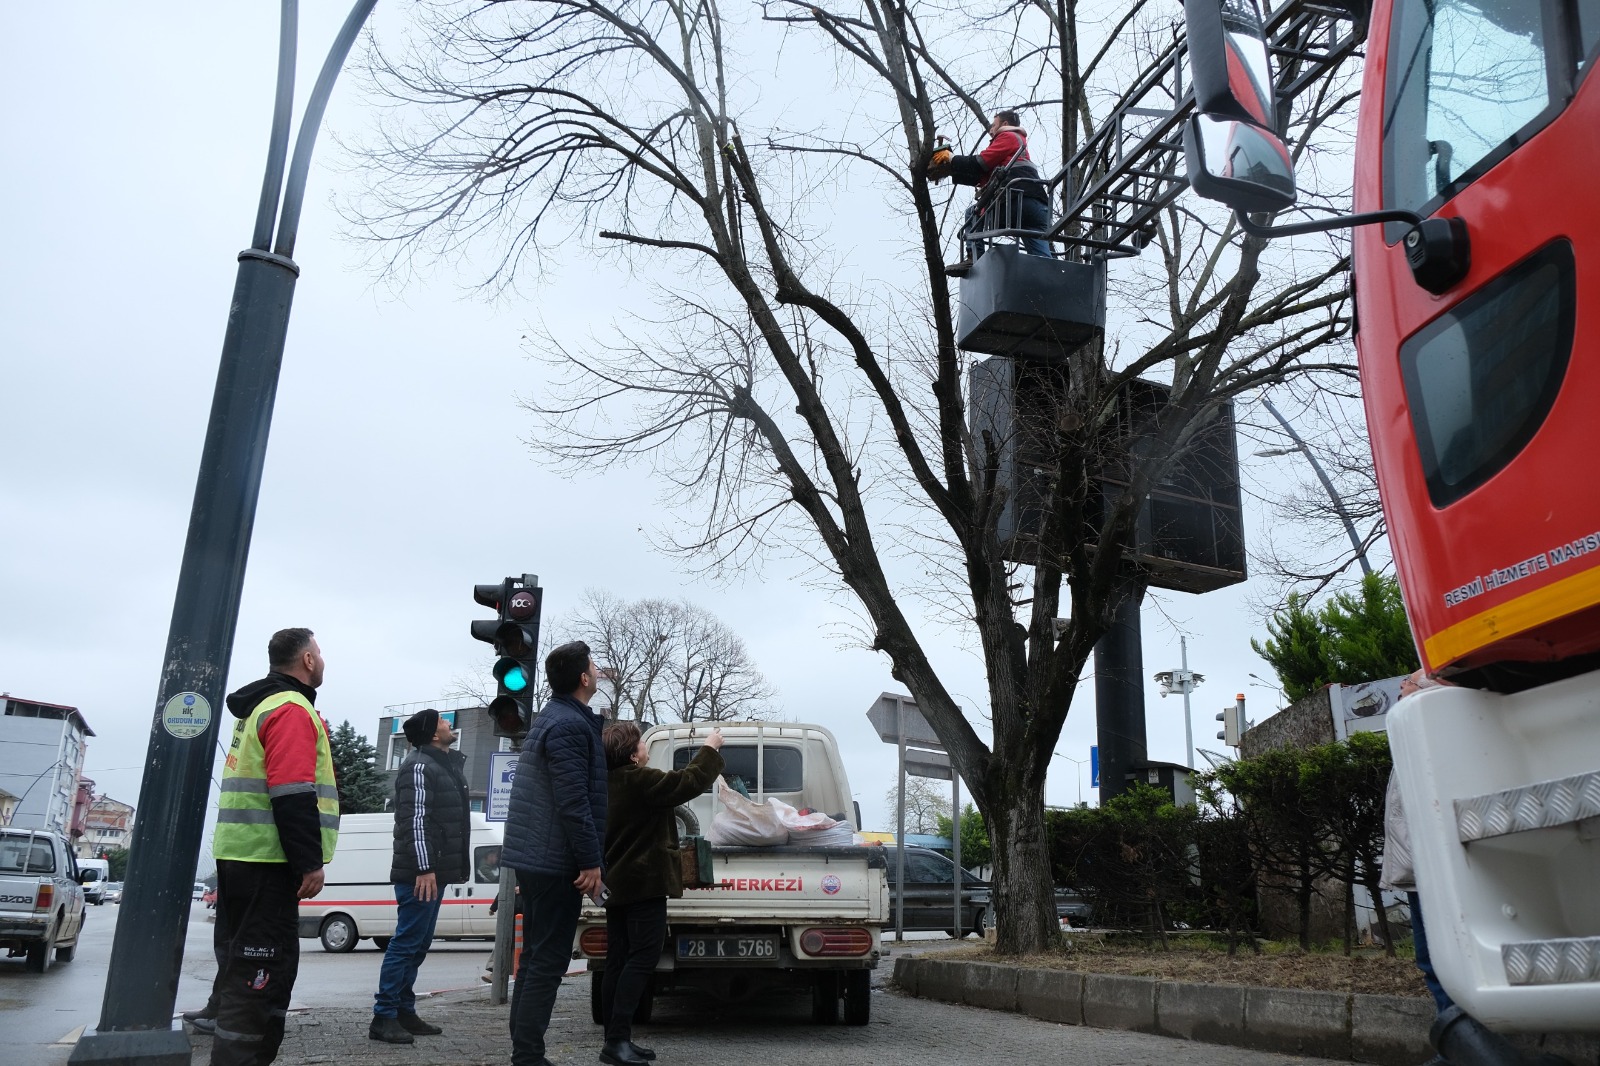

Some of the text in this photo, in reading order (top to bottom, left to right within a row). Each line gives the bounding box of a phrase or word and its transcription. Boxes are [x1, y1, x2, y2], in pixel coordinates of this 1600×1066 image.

[1444, 576, 1485, 608] RESMİ
[1484, 553, 1549, 591] HİZMETE
[721, 876, 803, 891] MERKEZİ
[0, 894, 33, 904] azda
[688, 940, 773, 956] 28 K 5766
